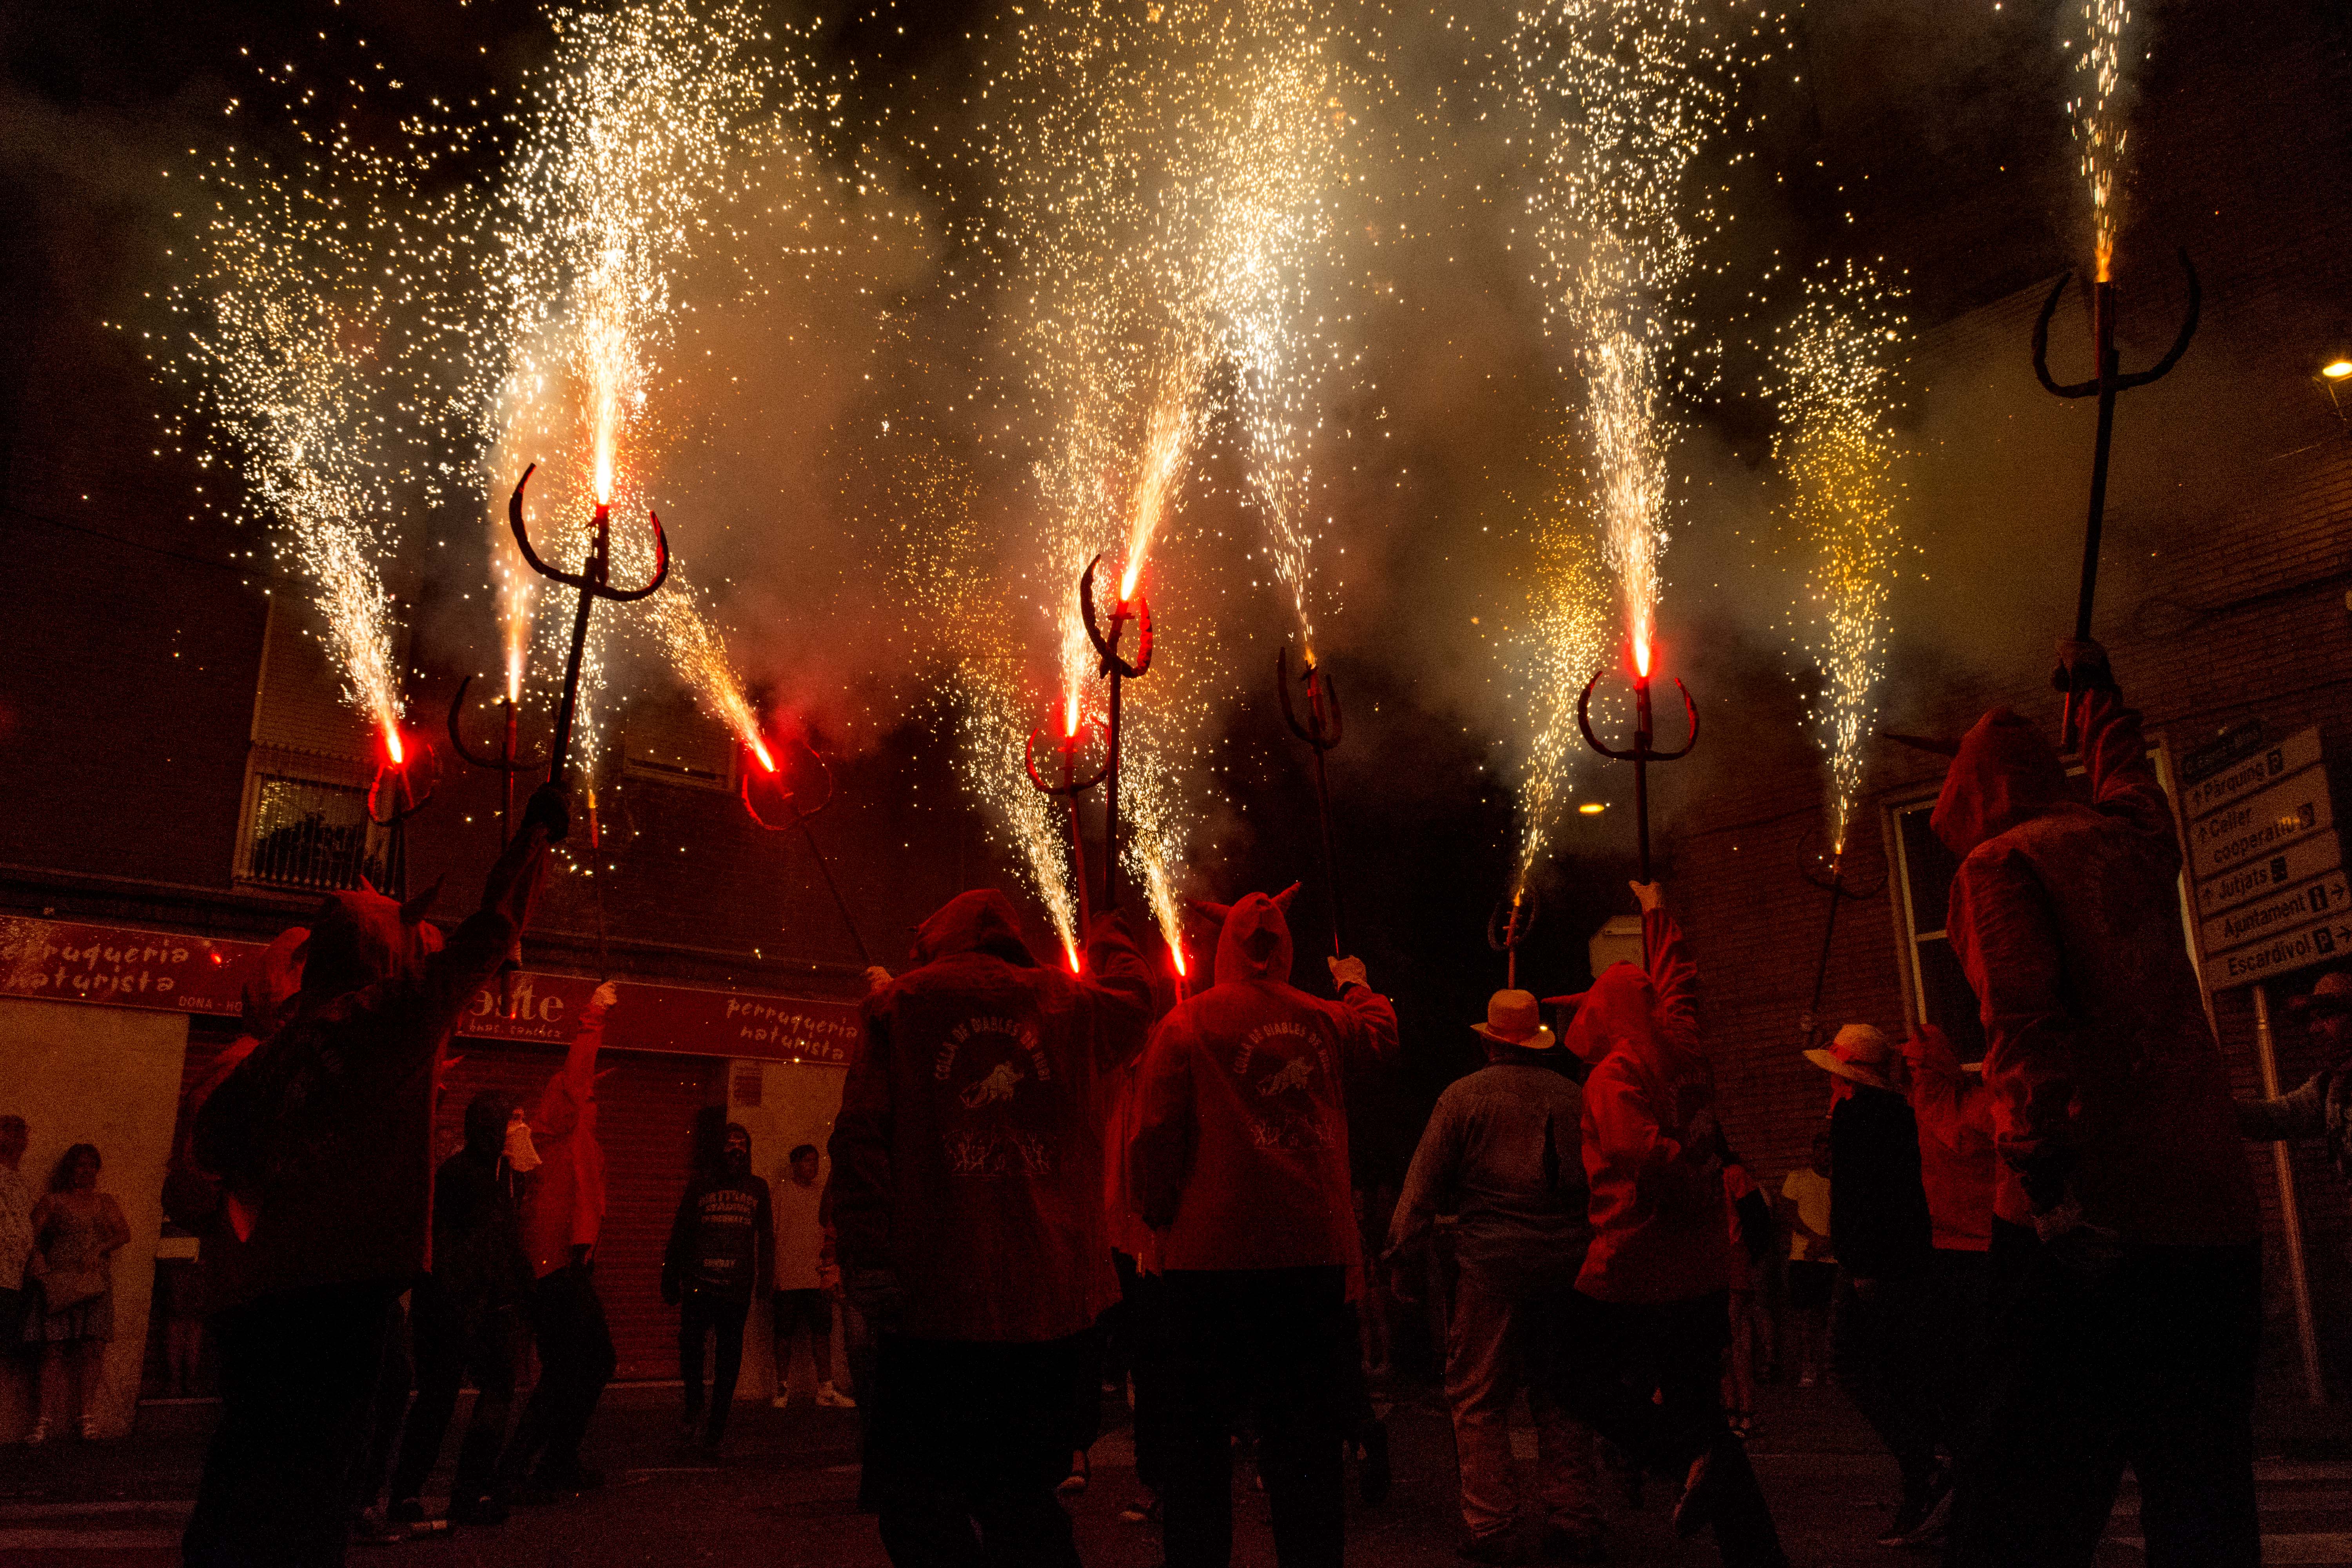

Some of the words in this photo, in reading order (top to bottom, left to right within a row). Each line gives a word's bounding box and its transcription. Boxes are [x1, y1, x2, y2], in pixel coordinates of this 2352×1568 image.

[2209, 807, 2252, 838] Celler
[2219, 869, 2268, 899] Jutjats
[2223, 893, 2306, 939] Ajuntament
[178, 995, 213, 1009] DONA
[726, 997, 858, 1038] perruqueria
[740, 1025, 844, 1060] naturista
[933, 1041, 959, 1081] COLLA
[951, 1022, 971, 1044] DE
[969, 1015, 1022, 1037] DIABLES
[1020, 1030, 1038, 1051] DE
[1232, 1042, 1254, 1074] COLLA
[1248, 1027, 1265, 1044] DE
[1262, 1022, 1307, 1038] DIABLES
